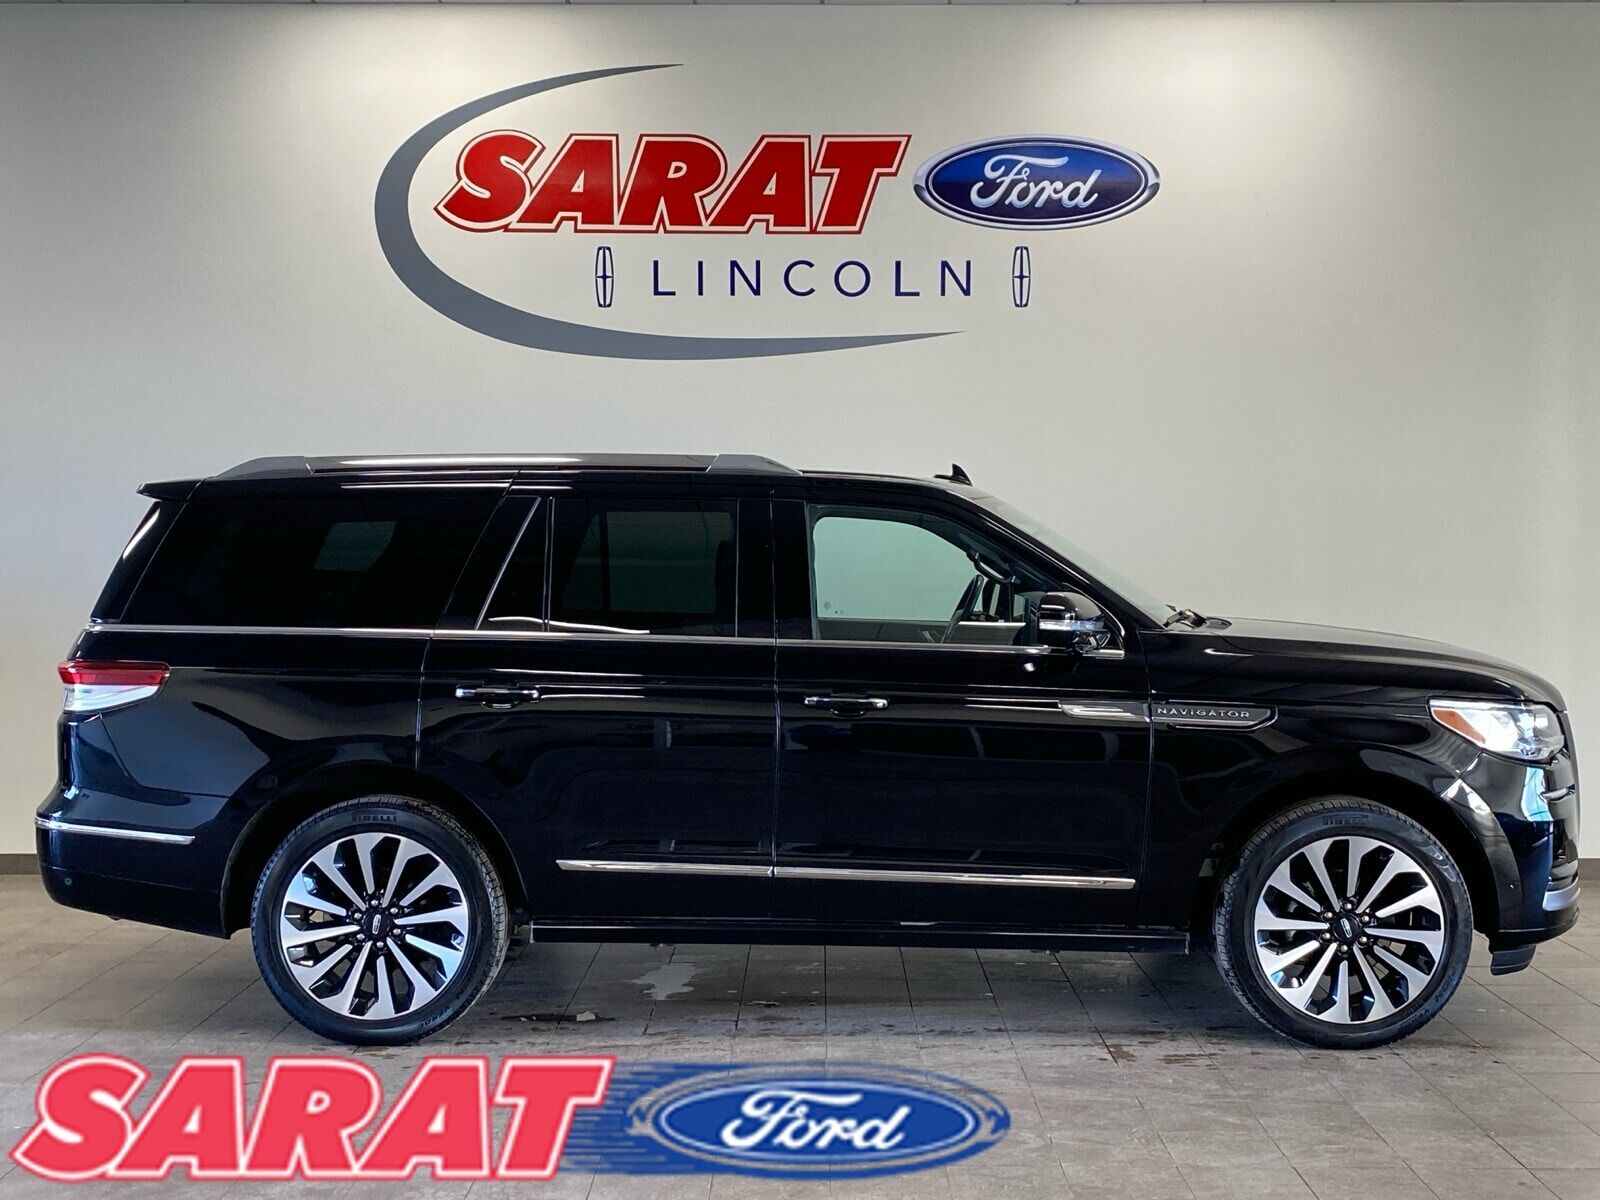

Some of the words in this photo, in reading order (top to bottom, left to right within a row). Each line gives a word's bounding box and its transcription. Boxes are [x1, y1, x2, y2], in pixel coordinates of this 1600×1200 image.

[434, 130, 911, 234] SARAT
[969, 154, 1102, 209] Ford
[652, 259, 972, 298] LINCOLN
[1157, 707, 1250, 718] NAVIGATOR
